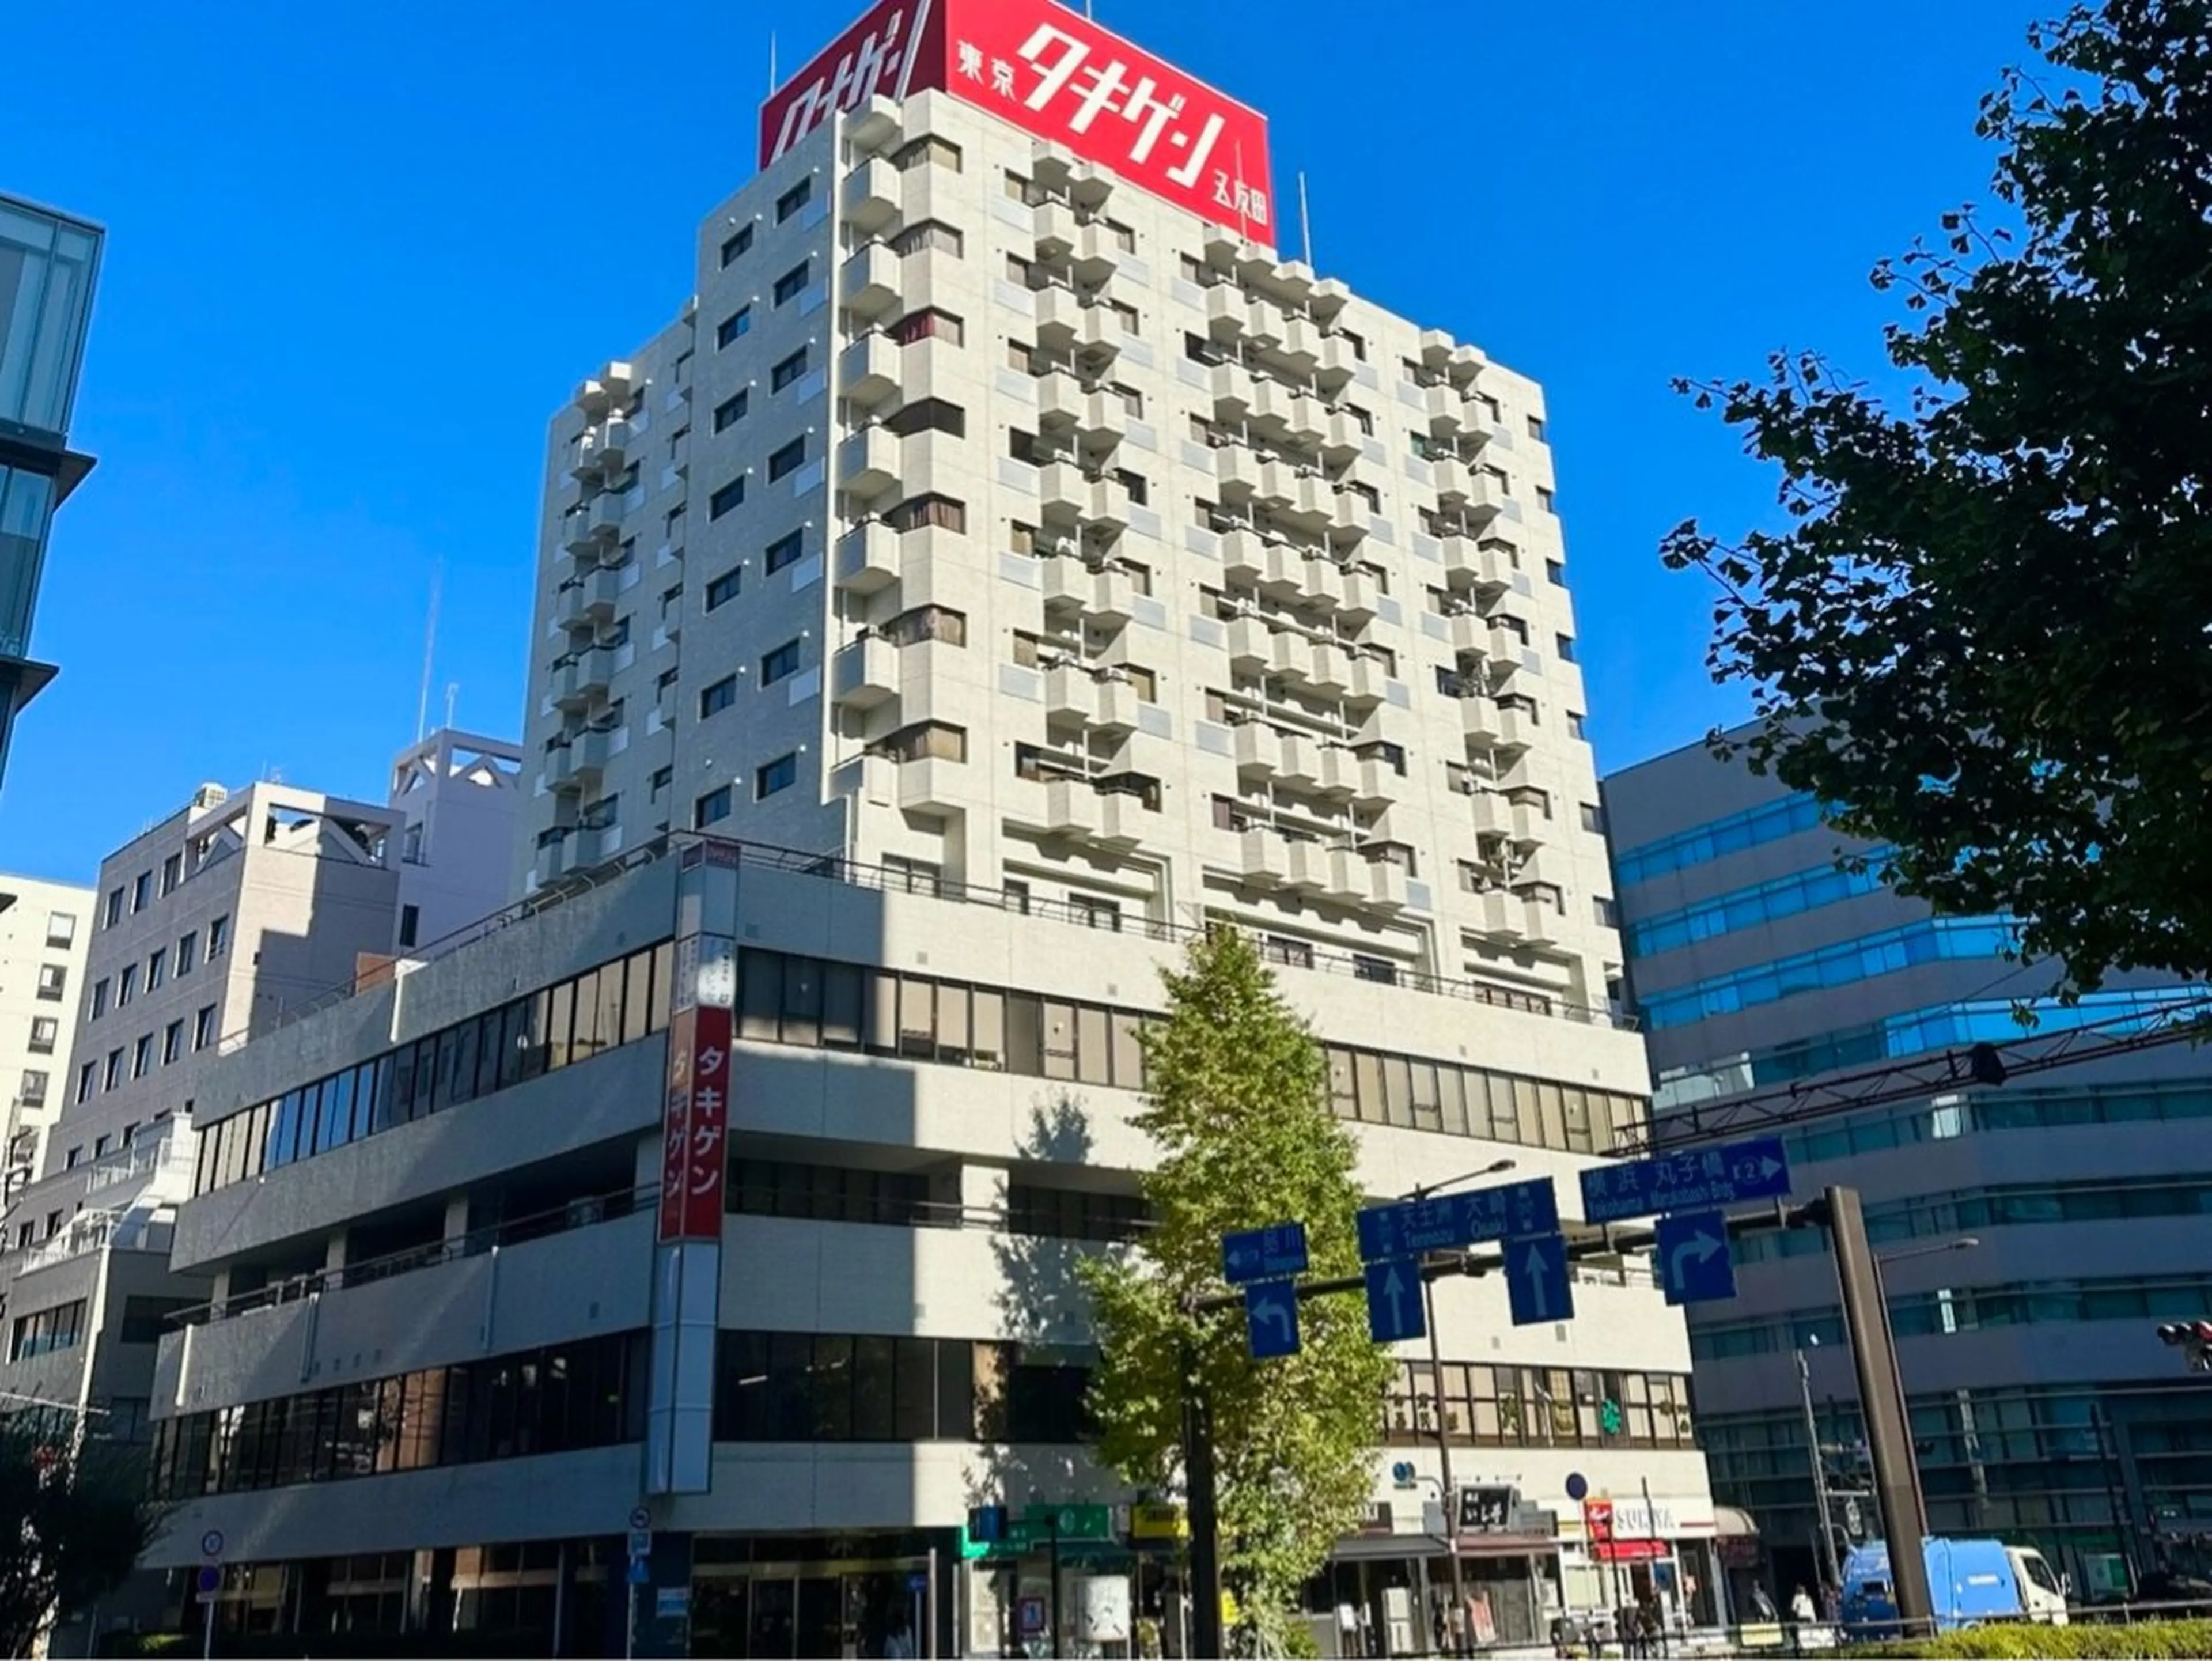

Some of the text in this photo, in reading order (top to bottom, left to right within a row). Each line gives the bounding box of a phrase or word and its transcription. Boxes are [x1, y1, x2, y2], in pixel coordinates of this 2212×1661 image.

[957, 22, 1267, 225] 東京 タキゲン 五反田
[691, 1046, 724, 1195] タキゲン
